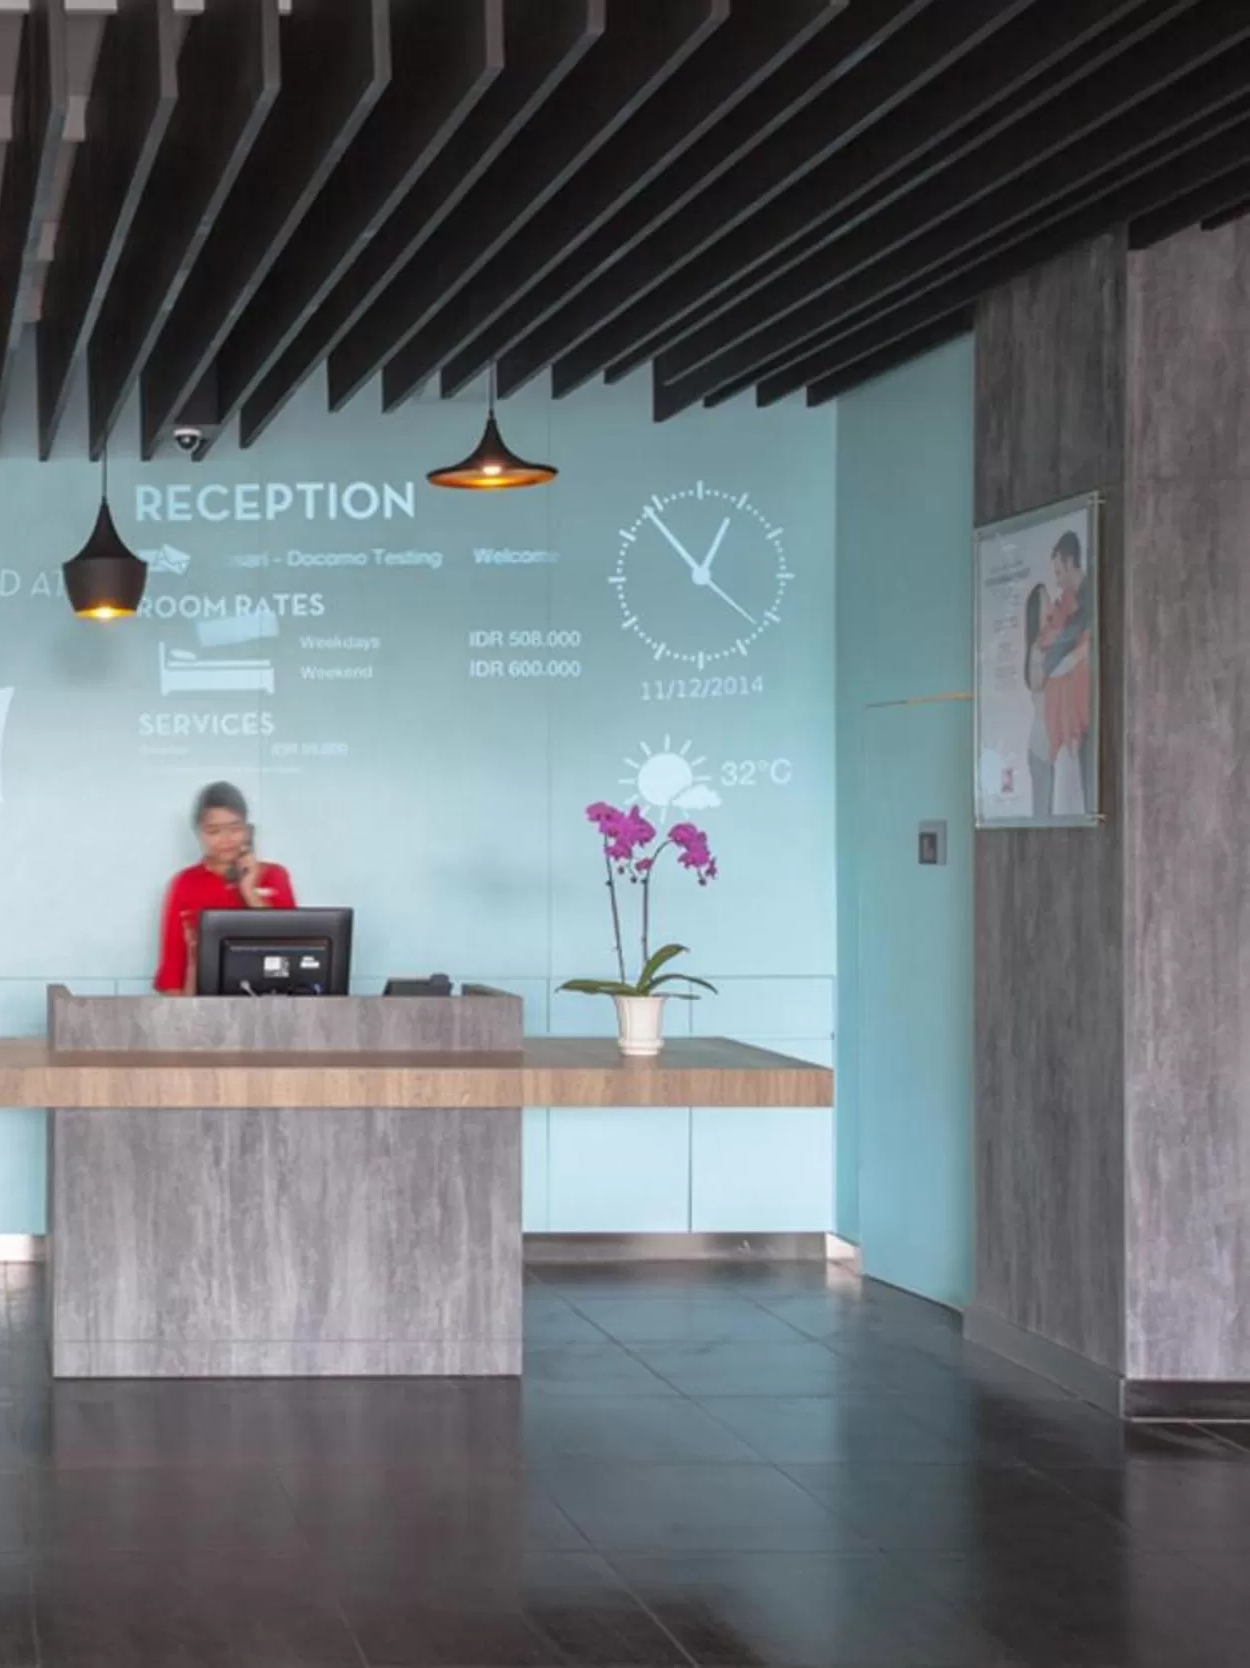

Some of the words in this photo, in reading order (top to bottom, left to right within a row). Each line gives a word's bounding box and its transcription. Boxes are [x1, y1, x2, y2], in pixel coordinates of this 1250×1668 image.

[135, 481, 416, 522] RECEPTION
[371, 548, 444, 569] Testing
[136, 595, 226, 619] ROOM
[235, 592, 326, 618] RATES
[298, 634, 382, 651] Weekdays
[469, 629, 504, 648] IDR
[299, 664, 374, 680] Weekend
[469, 659, 504, 678] IDR
[508, 659, 583, 679] 600.000
[640, 675, 764, 701] 11/12/2014
[138, 711, 276, 737] SERVICES
[720, 757, 793, 787] 32°C
